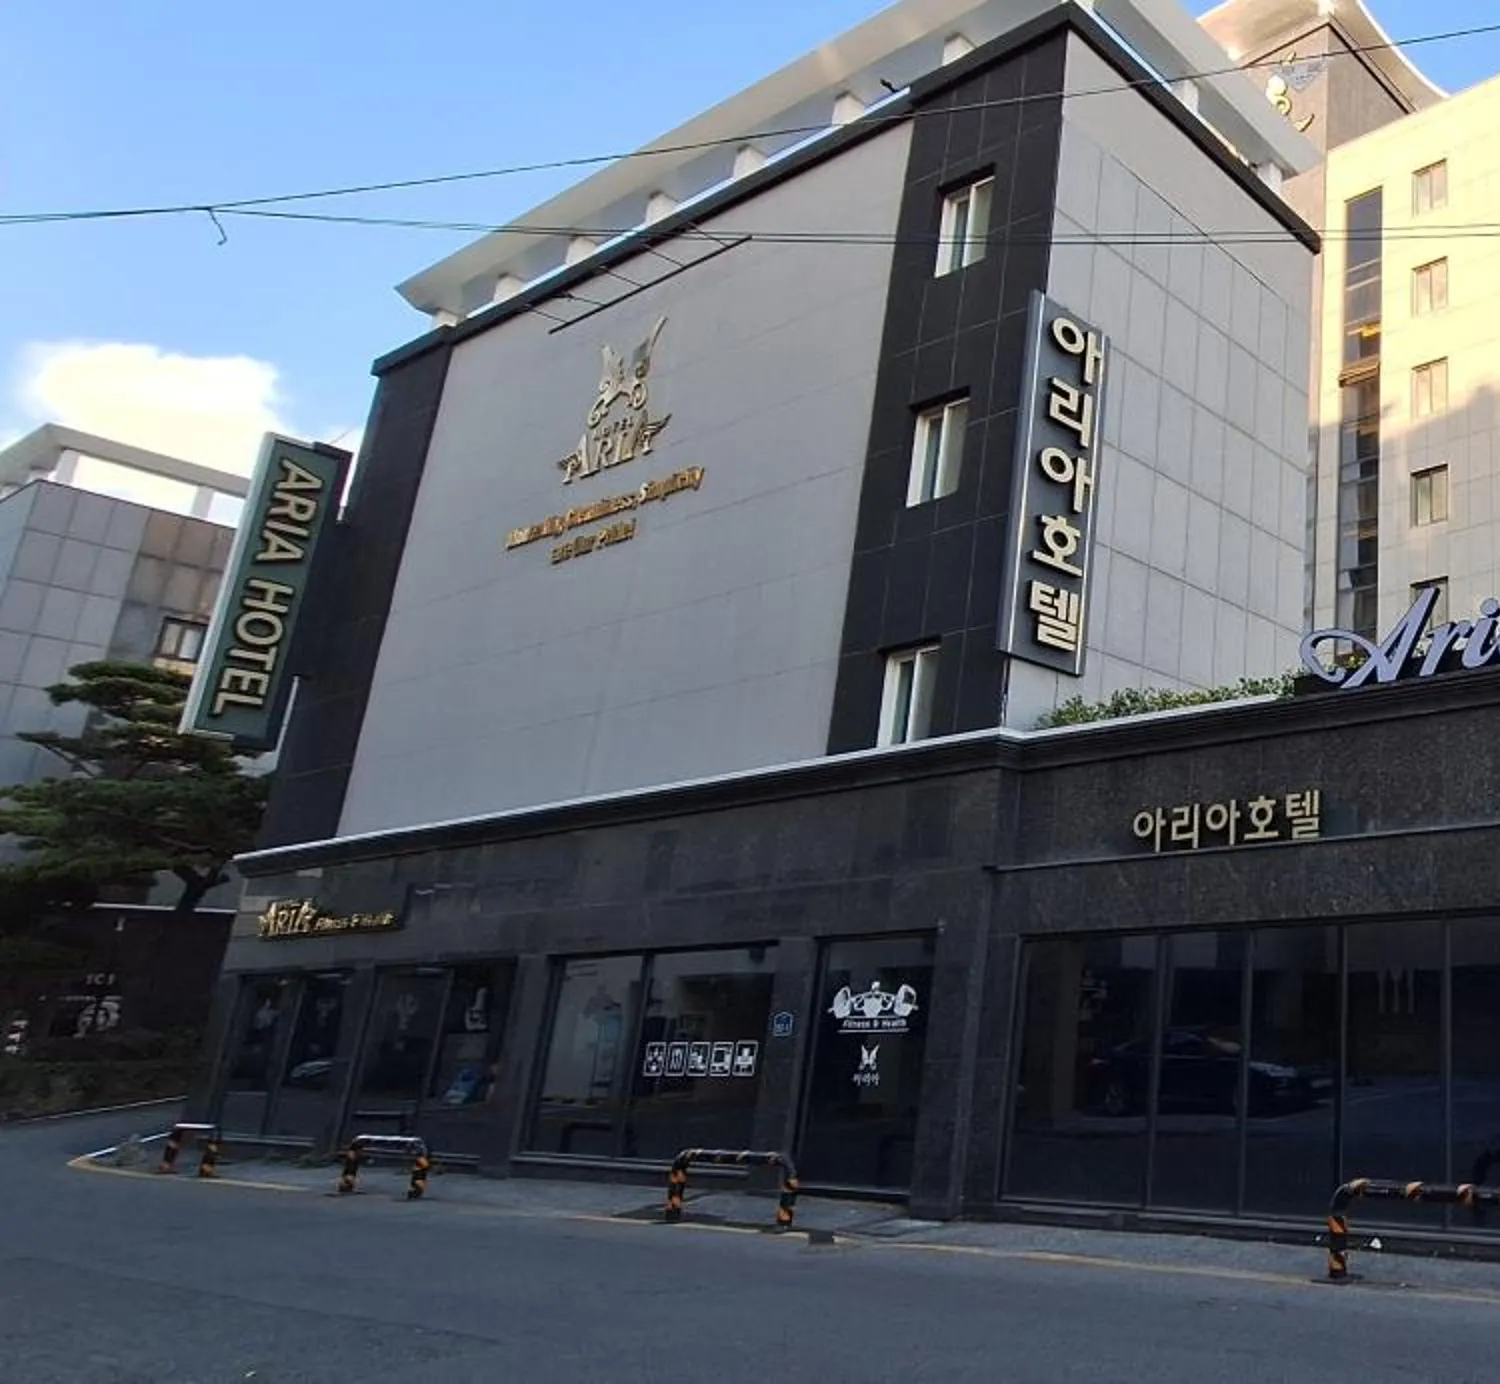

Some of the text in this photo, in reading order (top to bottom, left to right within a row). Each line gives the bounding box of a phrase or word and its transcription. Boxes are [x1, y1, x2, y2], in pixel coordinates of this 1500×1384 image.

[558, 424, 664, 484] ARIA
[1029, 315, 1103, 651] 아리아호텔
[208, 459, 323, 716] ARIA HOTEL
[1133, 789, 1321, 853] 아리아호텔
